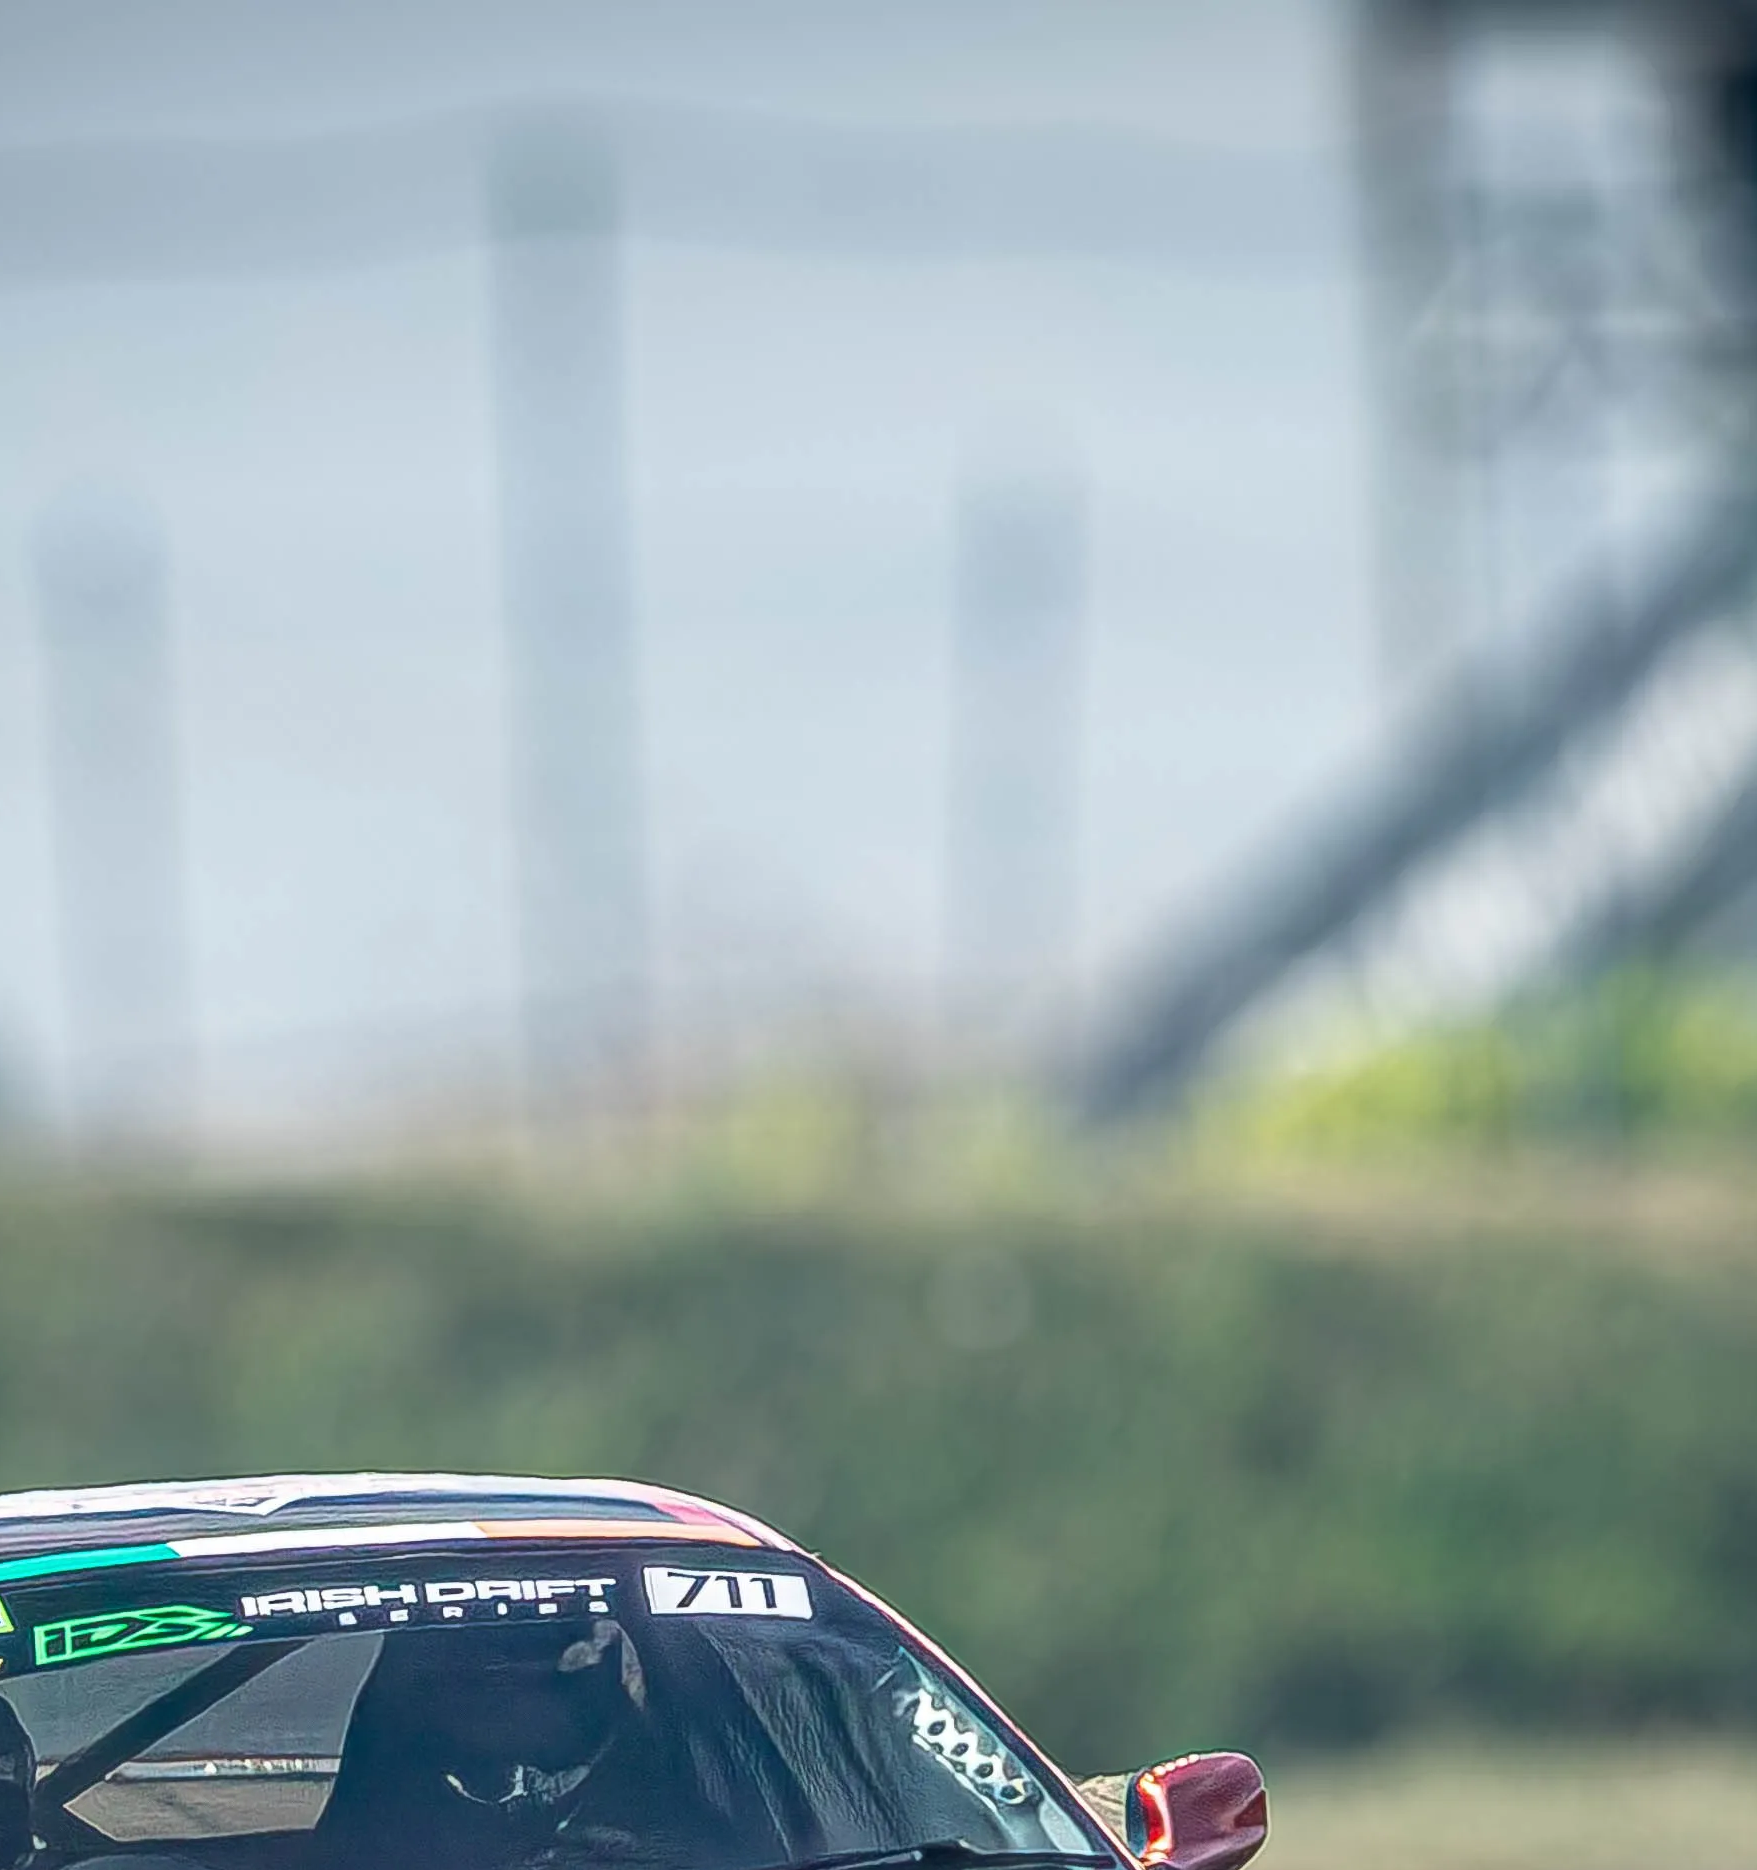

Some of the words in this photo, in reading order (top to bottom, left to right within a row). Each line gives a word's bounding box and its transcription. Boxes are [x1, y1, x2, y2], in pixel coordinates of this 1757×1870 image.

[241, 1582, 419, 1617] IRISH
[424, 1578, 616, 1603] DRIFT
[667, 1571, 778, 1609] 711
